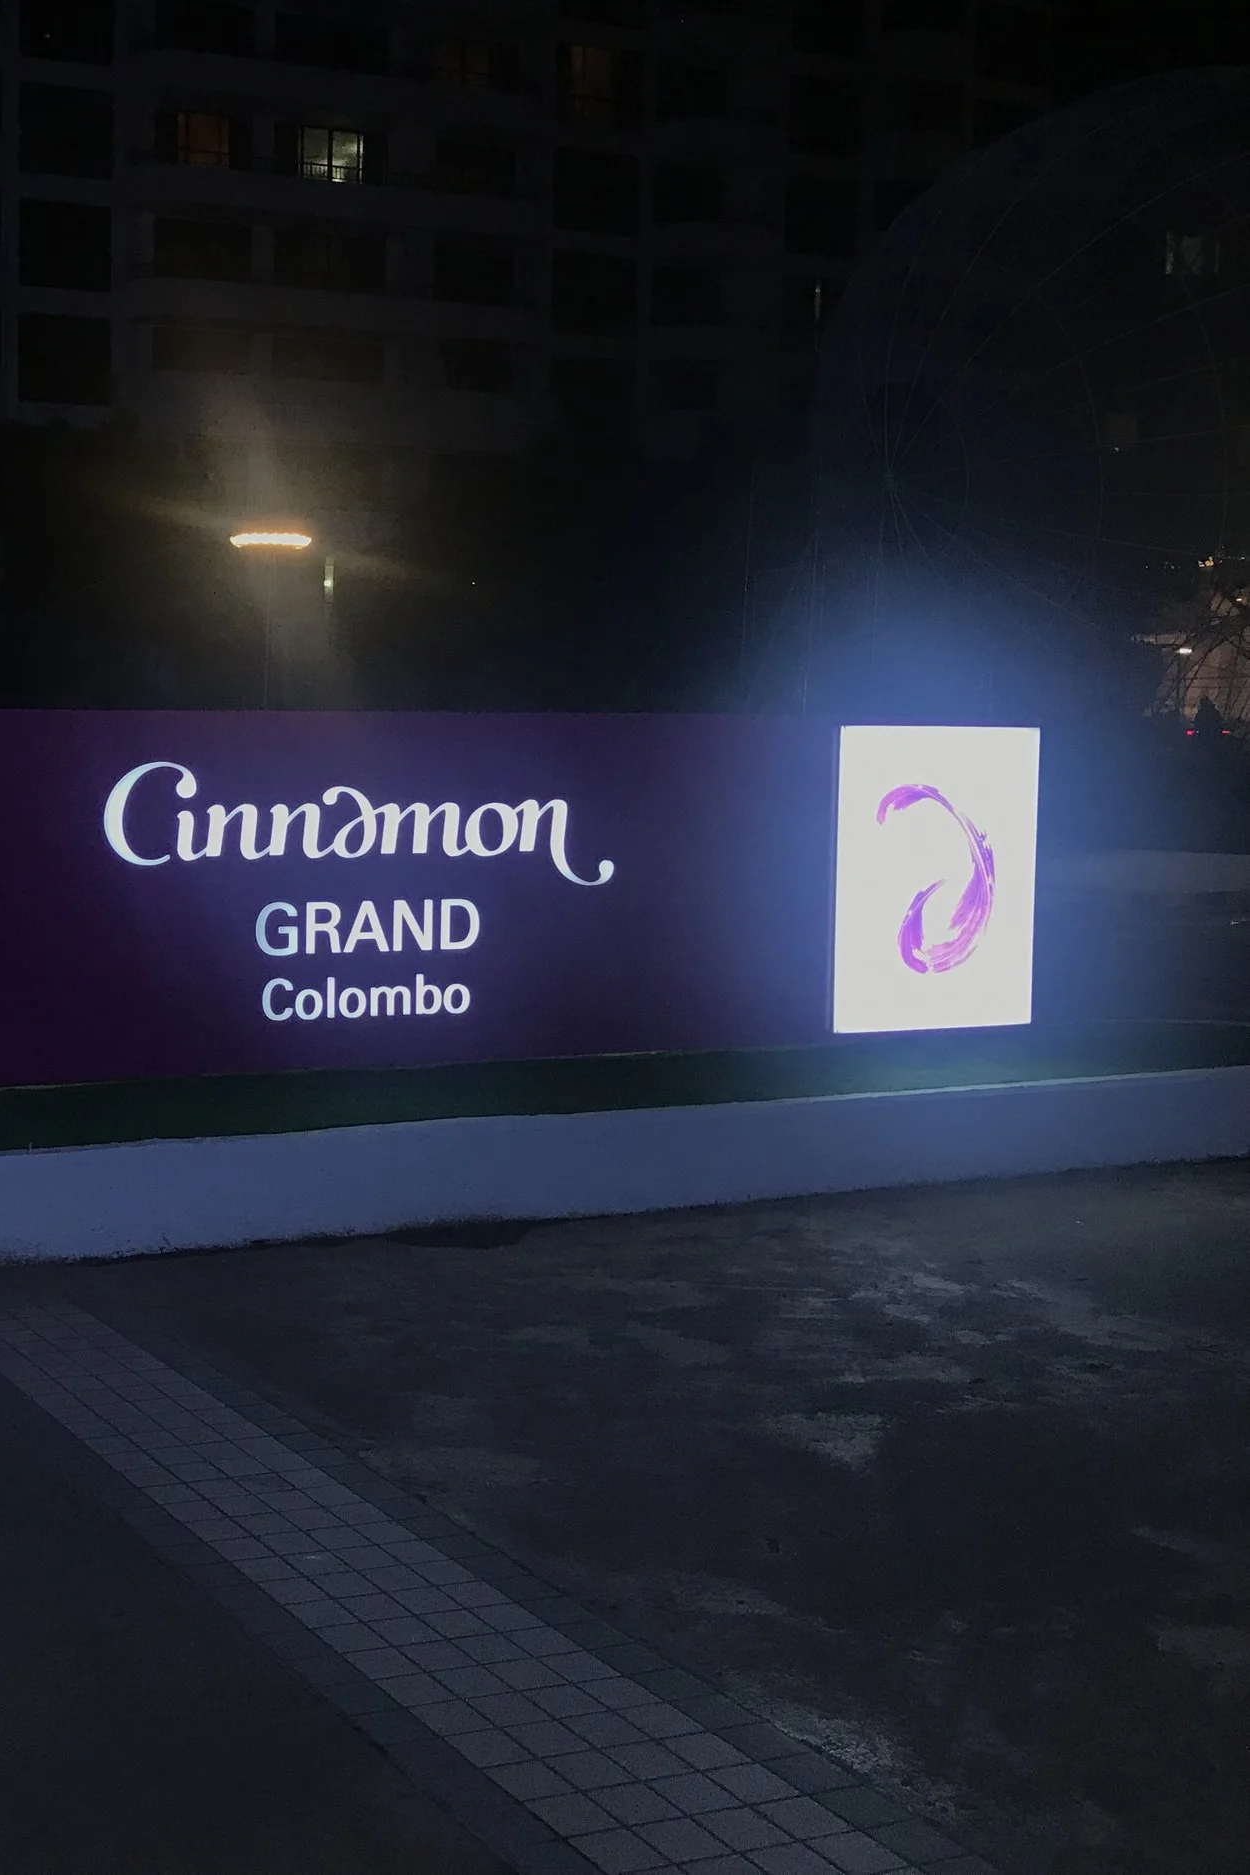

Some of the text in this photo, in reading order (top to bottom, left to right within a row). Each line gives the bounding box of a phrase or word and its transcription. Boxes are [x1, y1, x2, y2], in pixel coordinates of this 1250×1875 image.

[104, 761, 615, 886] Cinnamon
[255, 898, 480, 956] GRAND
[262, 974, 471, 1021] Colombo
